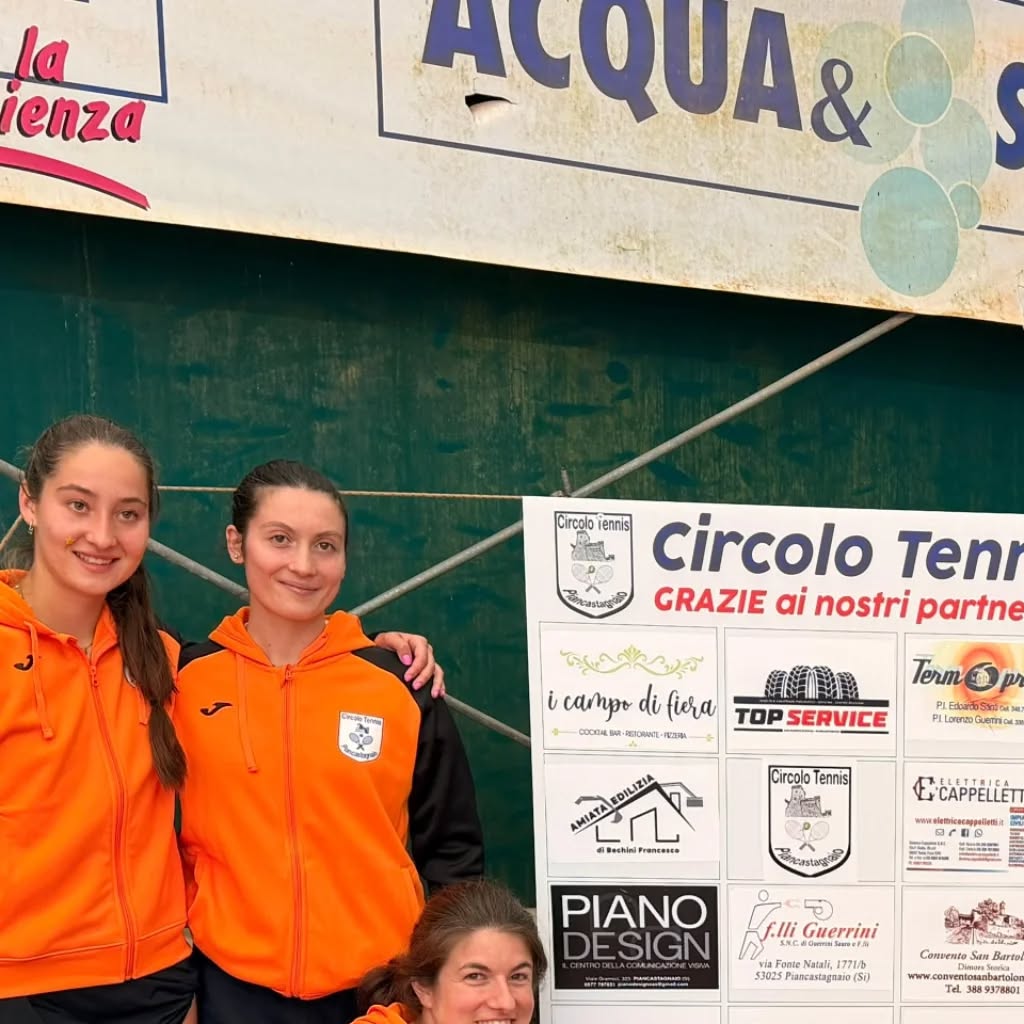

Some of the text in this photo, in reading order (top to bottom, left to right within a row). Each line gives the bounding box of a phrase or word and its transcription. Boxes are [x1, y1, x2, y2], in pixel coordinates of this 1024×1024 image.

[15, 25, 69, 84] la
[422, 0, 803, 131] ACQUA
[557, 514, 594, 530] Circolo
[652, 512, 874, 578] Circolo
[654, 585, 768, 614] GRAZIE
[776, 586, 808, 616] ai
[814, 589, 912, 618] nostri
[548, 683, 717, 722] i campo di fiera
[735, 708, 888, 728] TOP SERVICE
[771, 769, 849, 785] Circolo Tennis
[940, 778, 1009, 787] ELETTRICA
[570, 774, 655, 832] AMIATA EDILIZIA
[774, 847, 844, 867] Piancastagnaio
[561, 894, 708, 929] PIANO
[760, 922, 880, 942] f.lli Guerrini
[563, 931, 710, 961] DESIGN
[920, 949, 967, 960] Convento
[970, 950, 989, 961] San
[759, 960, 772, 969] via
[775, 960, 800, 969] Fonte
[958, 963, 984, 971] Dimora
[755, 971, 782, 981] 53025
[785, 972, 850, 983] Piancastagnaio
[945, 984, 962, 994] Tel.
[966, 985, 982, 994] 388
